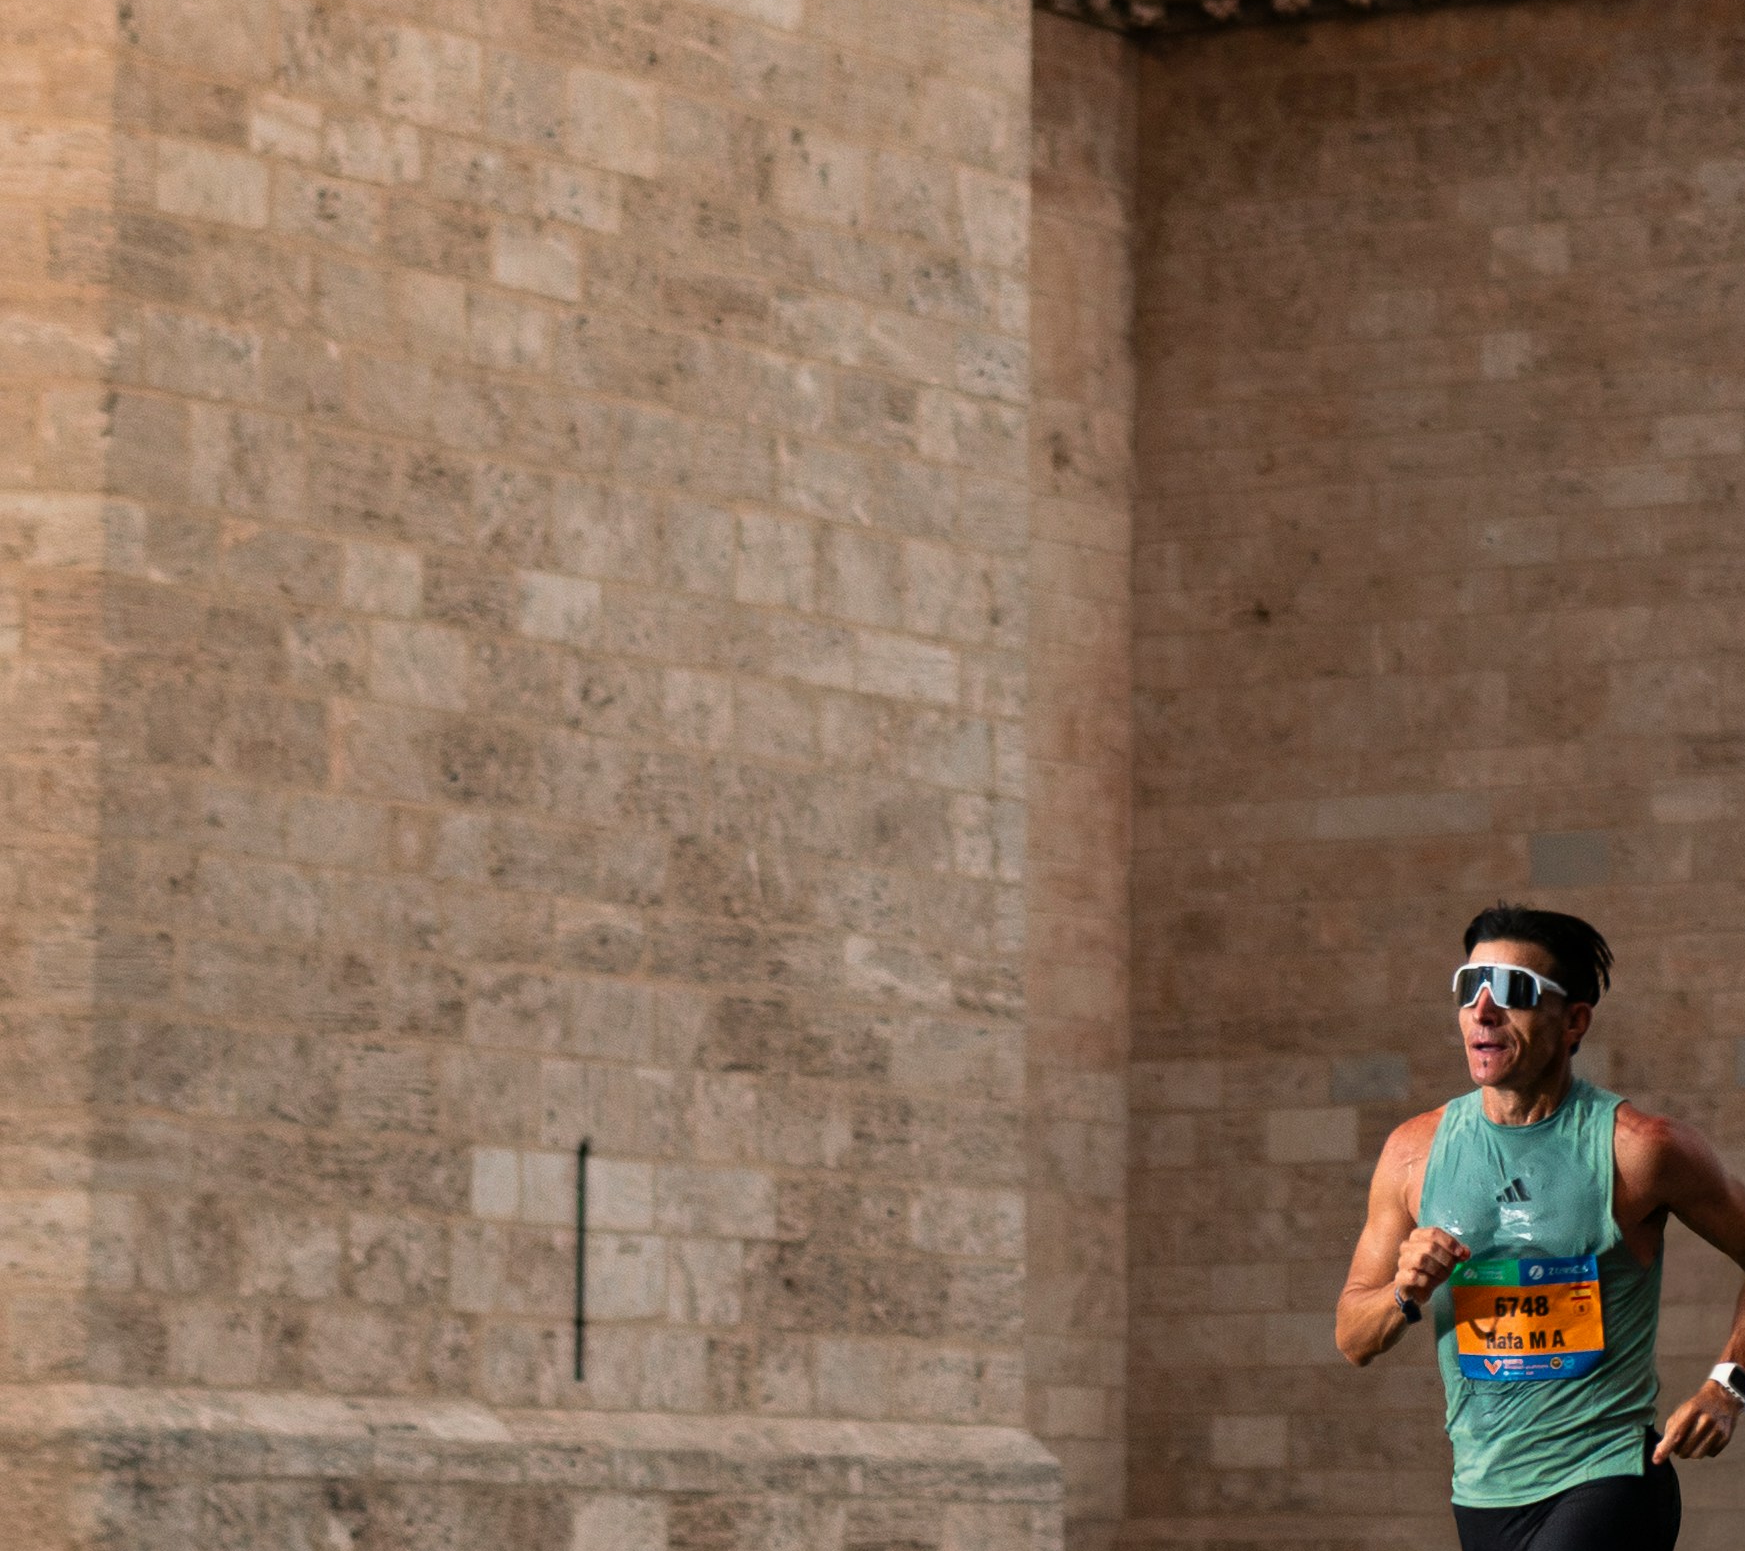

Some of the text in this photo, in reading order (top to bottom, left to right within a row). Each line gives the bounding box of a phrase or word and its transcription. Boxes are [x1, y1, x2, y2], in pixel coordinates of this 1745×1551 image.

[1494, 1295, 1550, 1318] 6748
[1485, 1329, 1566, 1350] Rafa M A
